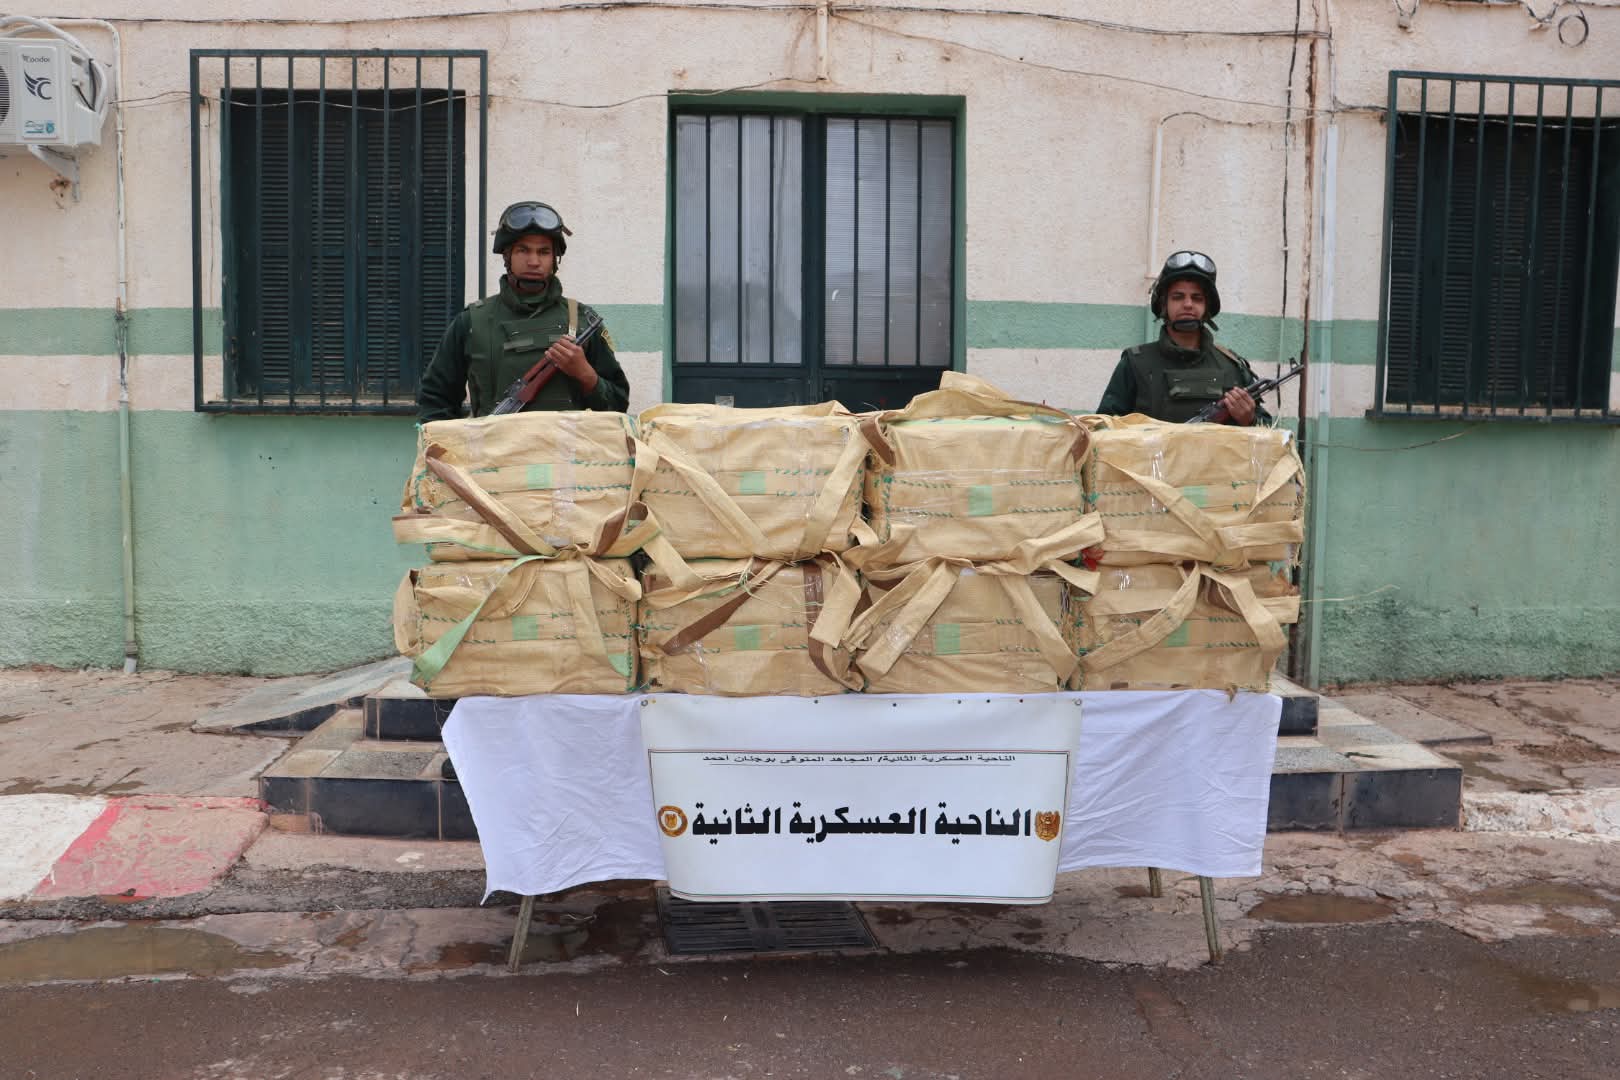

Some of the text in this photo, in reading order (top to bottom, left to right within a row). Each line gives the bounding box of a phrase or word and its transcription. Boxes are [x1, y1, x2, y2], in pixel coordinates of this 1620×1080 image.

[829, 754, 873, 764] المجاهد
[920, 754, 973, 764] العسكرية
[977, 754, 1016, 764] الناحية
[692, 801, 1031, 845] الناحية العسكرية الثانية
